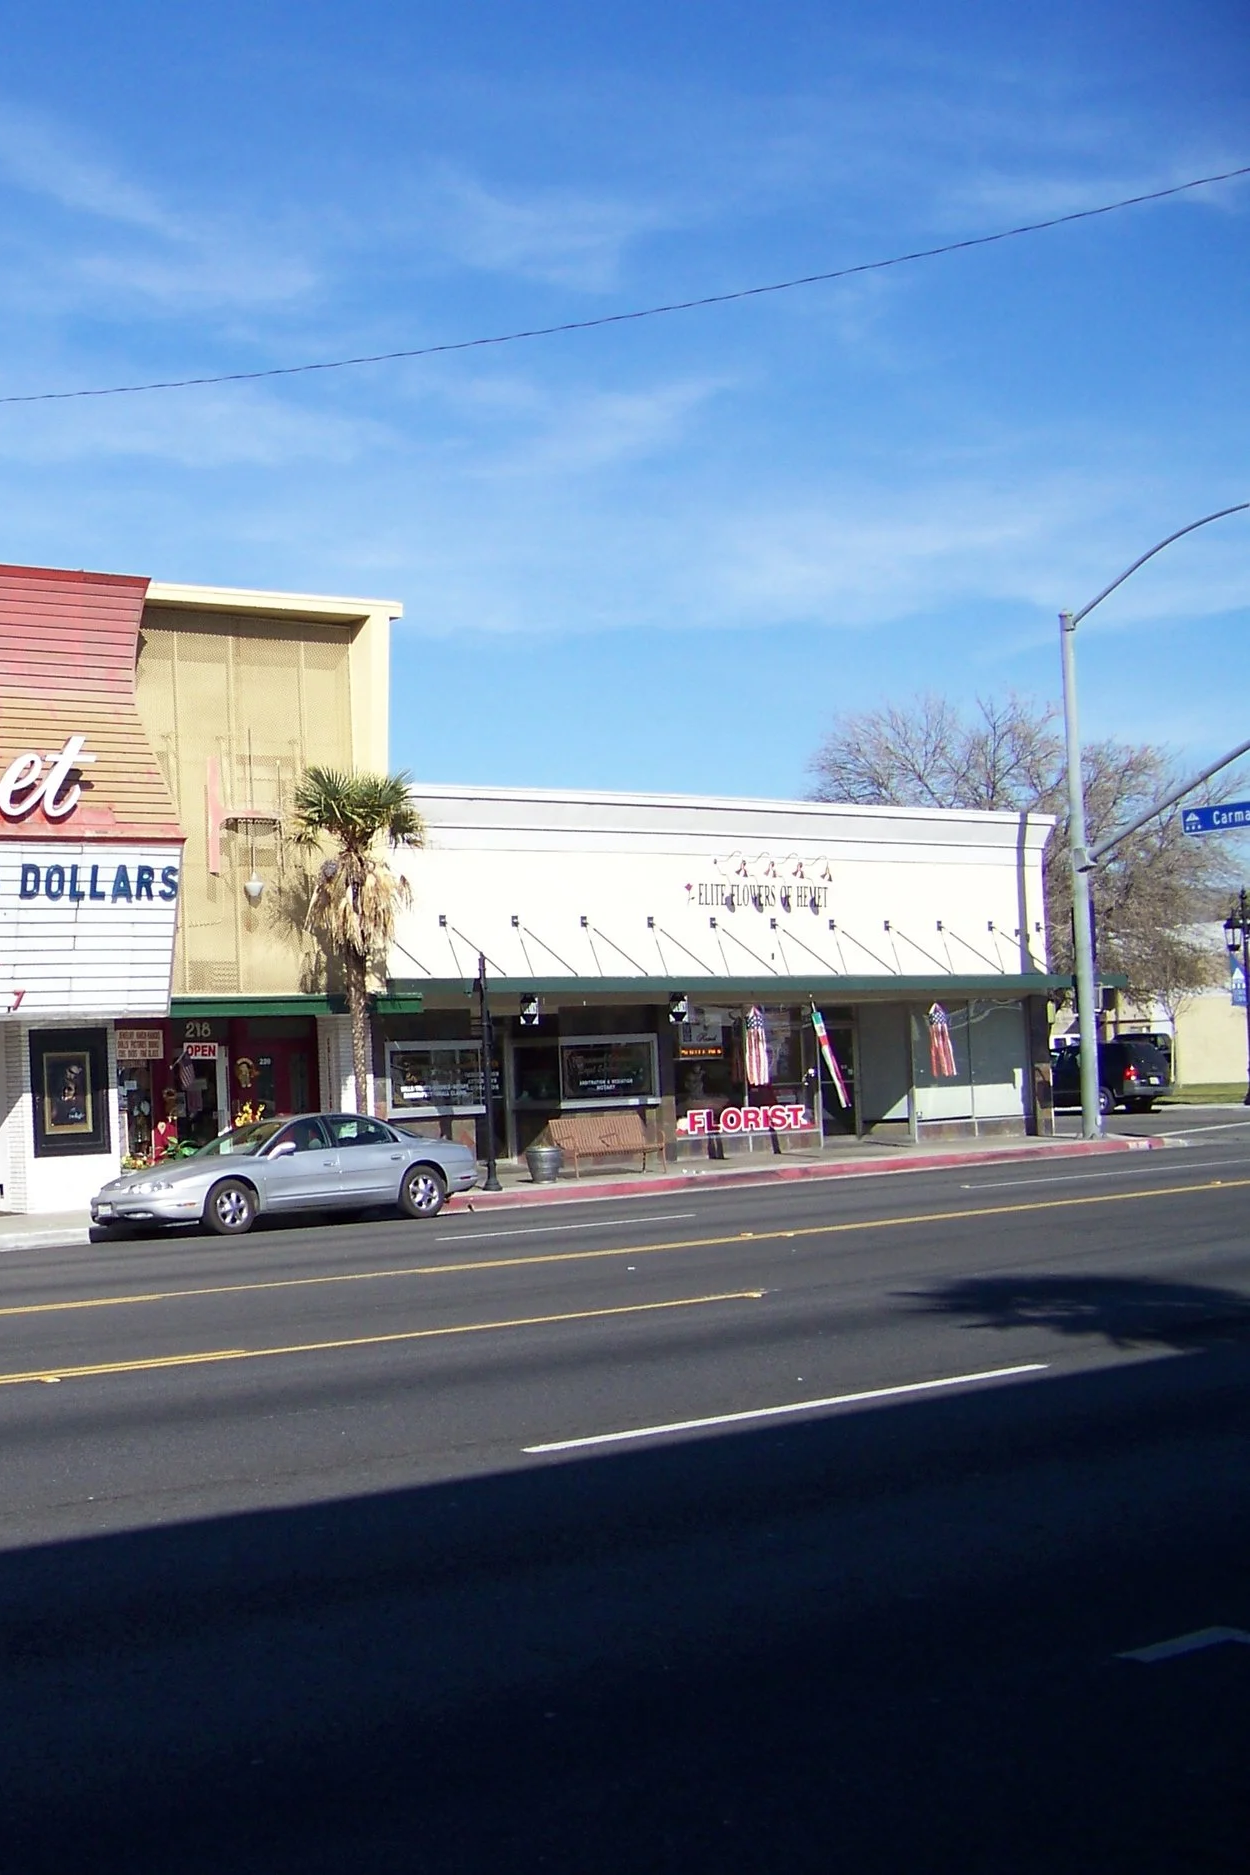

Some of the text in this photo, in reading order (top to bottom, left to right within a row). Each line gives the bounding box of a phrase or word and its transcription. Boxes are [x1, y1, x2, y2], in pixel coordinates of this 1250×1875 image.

[1213, 810, 1250, 825] Carma
[19, 864, 178, 902] DOLLARS
[698, 883, 828, 908] ELITE FLOWERS OF HEMET
[13, 990, 26, 1011] 7
[185, 1022, 211, 1037] 218
[186, 1044, 216, 1056] OPEN
[688, 1105, 805, 1134] FLORIST
